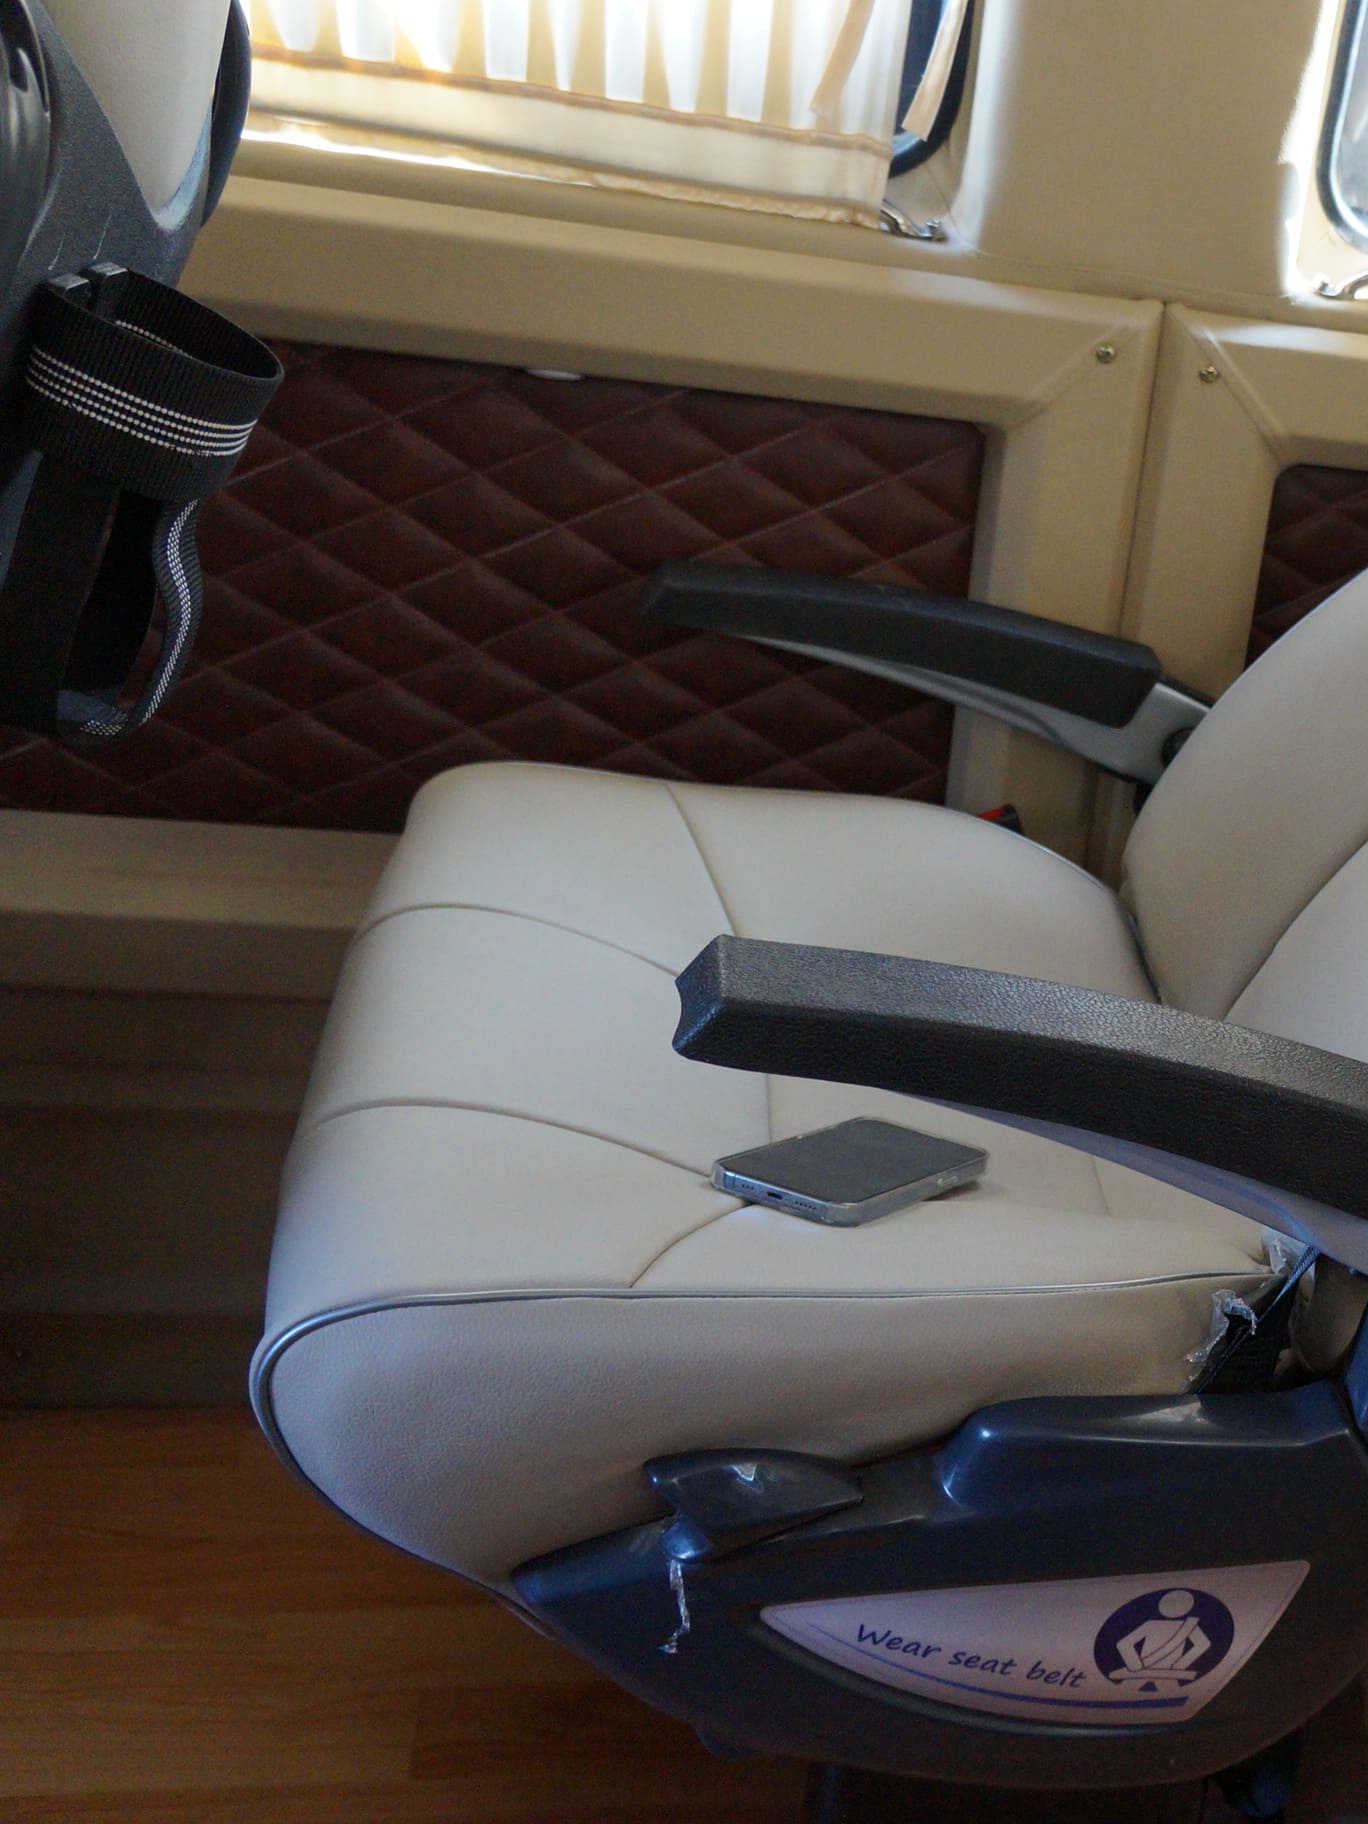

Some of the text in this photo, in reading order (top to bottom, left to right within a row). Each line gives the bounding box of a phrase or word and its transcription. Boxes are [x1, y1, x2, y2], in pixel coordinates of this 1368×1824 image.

[856, 1623, 1088, 1687] Wear seat belt
